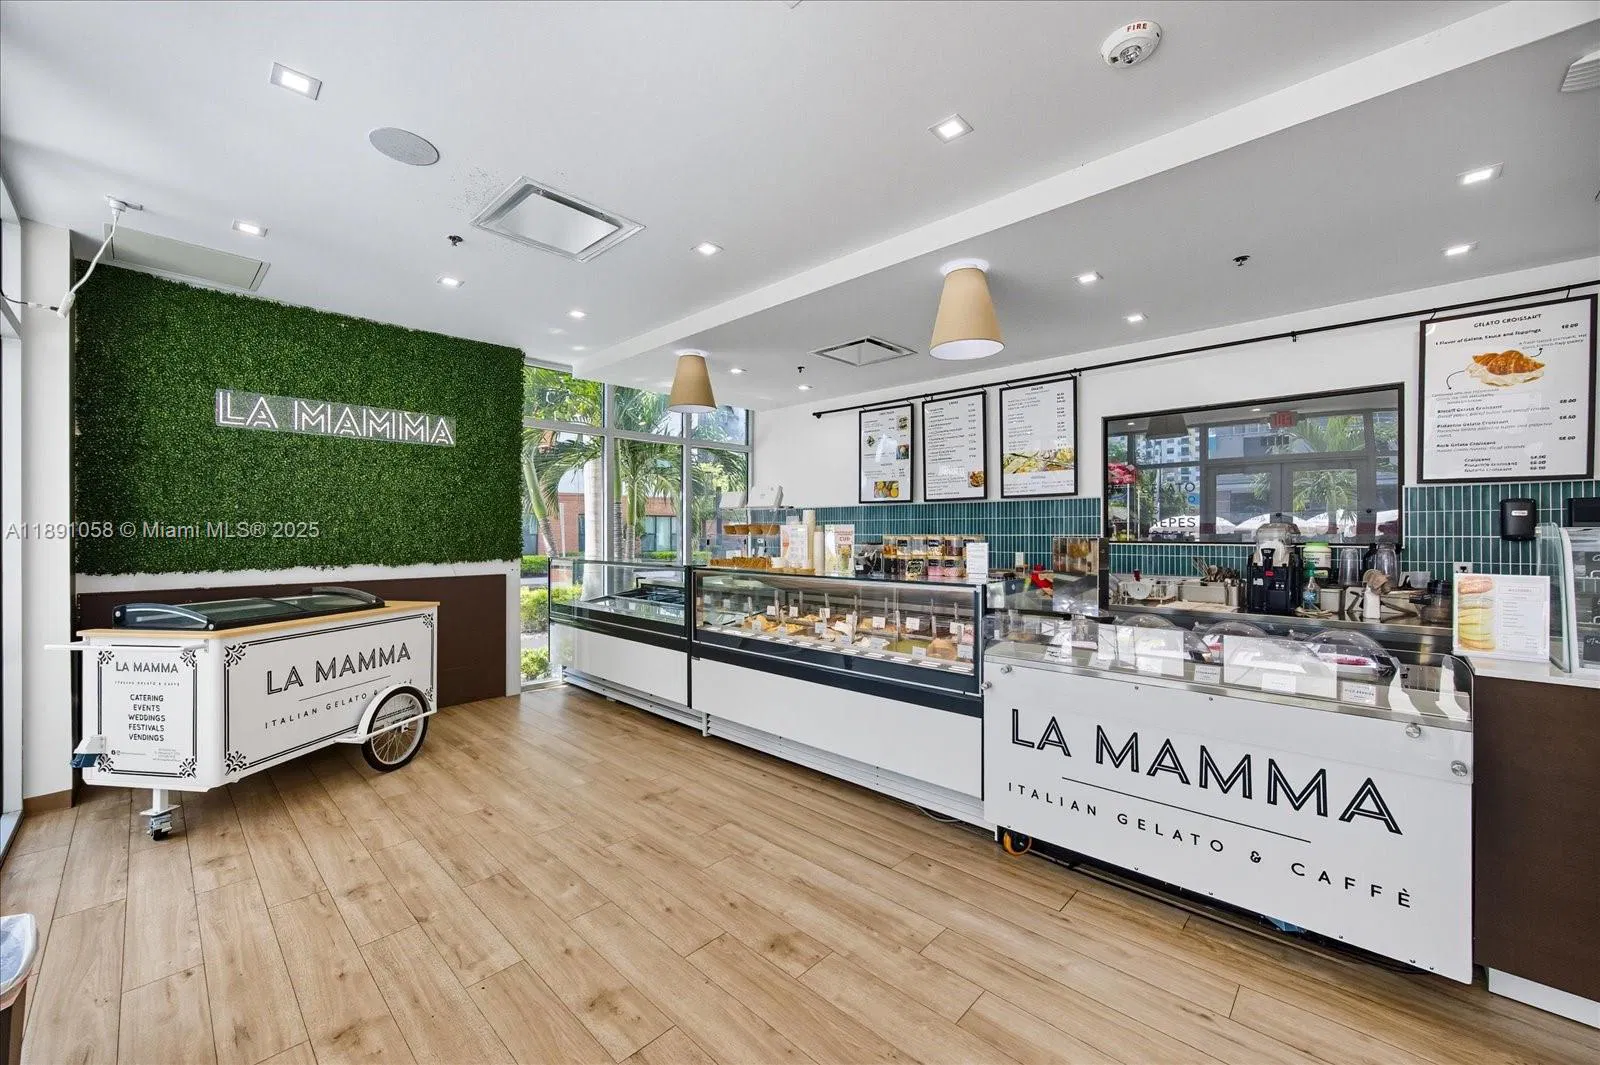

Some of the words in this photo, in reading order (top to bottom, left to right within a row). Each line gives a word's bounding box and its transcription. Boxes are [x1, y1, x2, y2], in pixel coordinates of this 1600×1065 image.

[1127, 23, 1147, 32] FIRE
[1473, 319, 1500, 328] GELATO
[1502, 313, 1542, 324] CROISSANT
[218, 391, 279, 428] LA
[294, 400, 454, 445] MAMMA
[115, 661, 130, 672] LA
[133, 662, 179, 673] MAMMA
[266, 665, 304, 696] LA
[315, 642, 411, 683] MAMMA
[129, 694, 164, 702] CATERING
[133, 704, 161, 712] EVENTS
[265, 708, 318, 729] ITALIAN
[326, 694, 367, 711] GELATO
[128, 714, 166, 722] WEDDINGS
[128, 723, 165, 732] FESTIVALS
[128, 733, 165, 742] VENDINGS
[1011, 708, 1072, 758] LA
[1096, 724, 1403, 836] MAMMA
[1008, 782, 1098, 817] ITALIAN
[1117, 813, 1224, 853] GELATO
[1250, 851, 1262, 863] &
[1291, 862, 1411, 909] CAFFÈ
